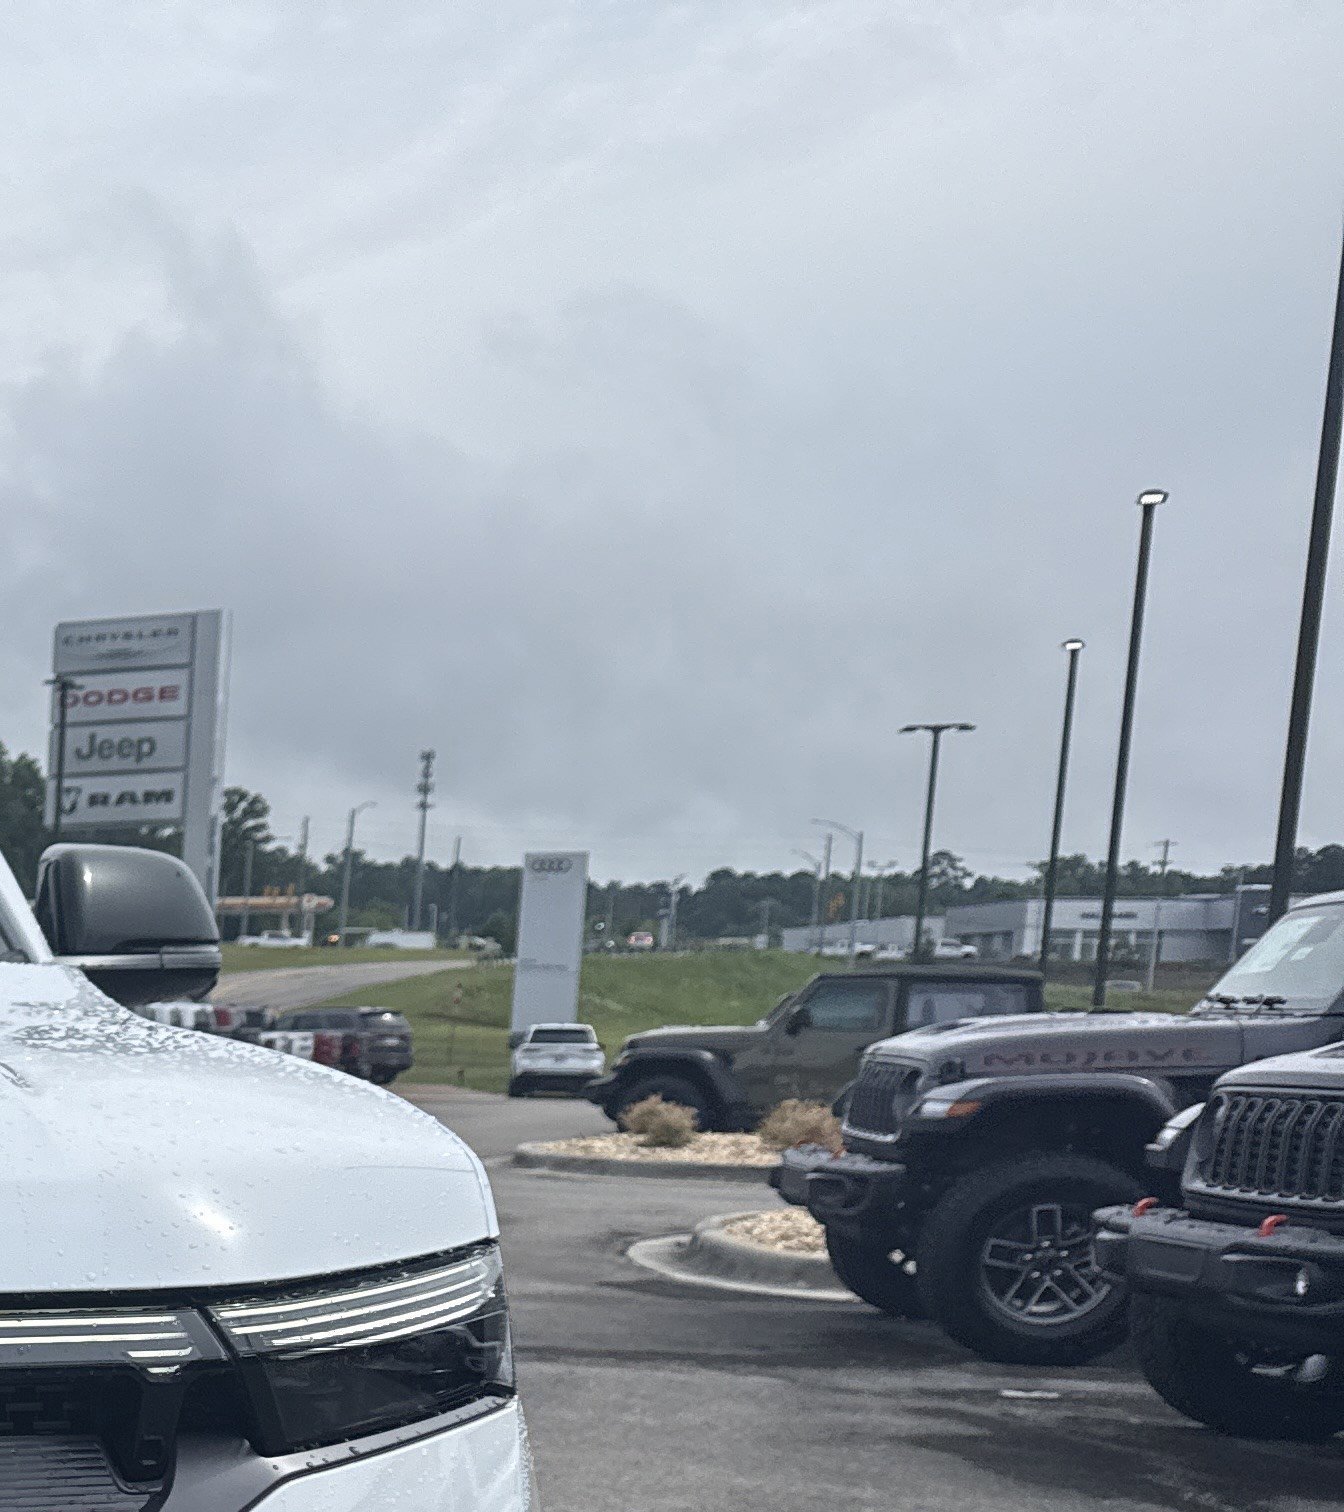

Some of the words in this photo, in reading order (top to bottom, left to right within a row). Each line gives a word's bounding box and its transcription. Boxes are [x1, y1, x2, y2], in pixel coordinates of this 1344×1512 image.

[61, 626, 180, 646] CHRYSLER
[56, 685, 180, 710] DODGE
[75, 732, 157, 764] Jeep
[87, 788, 175, 808] RAM
